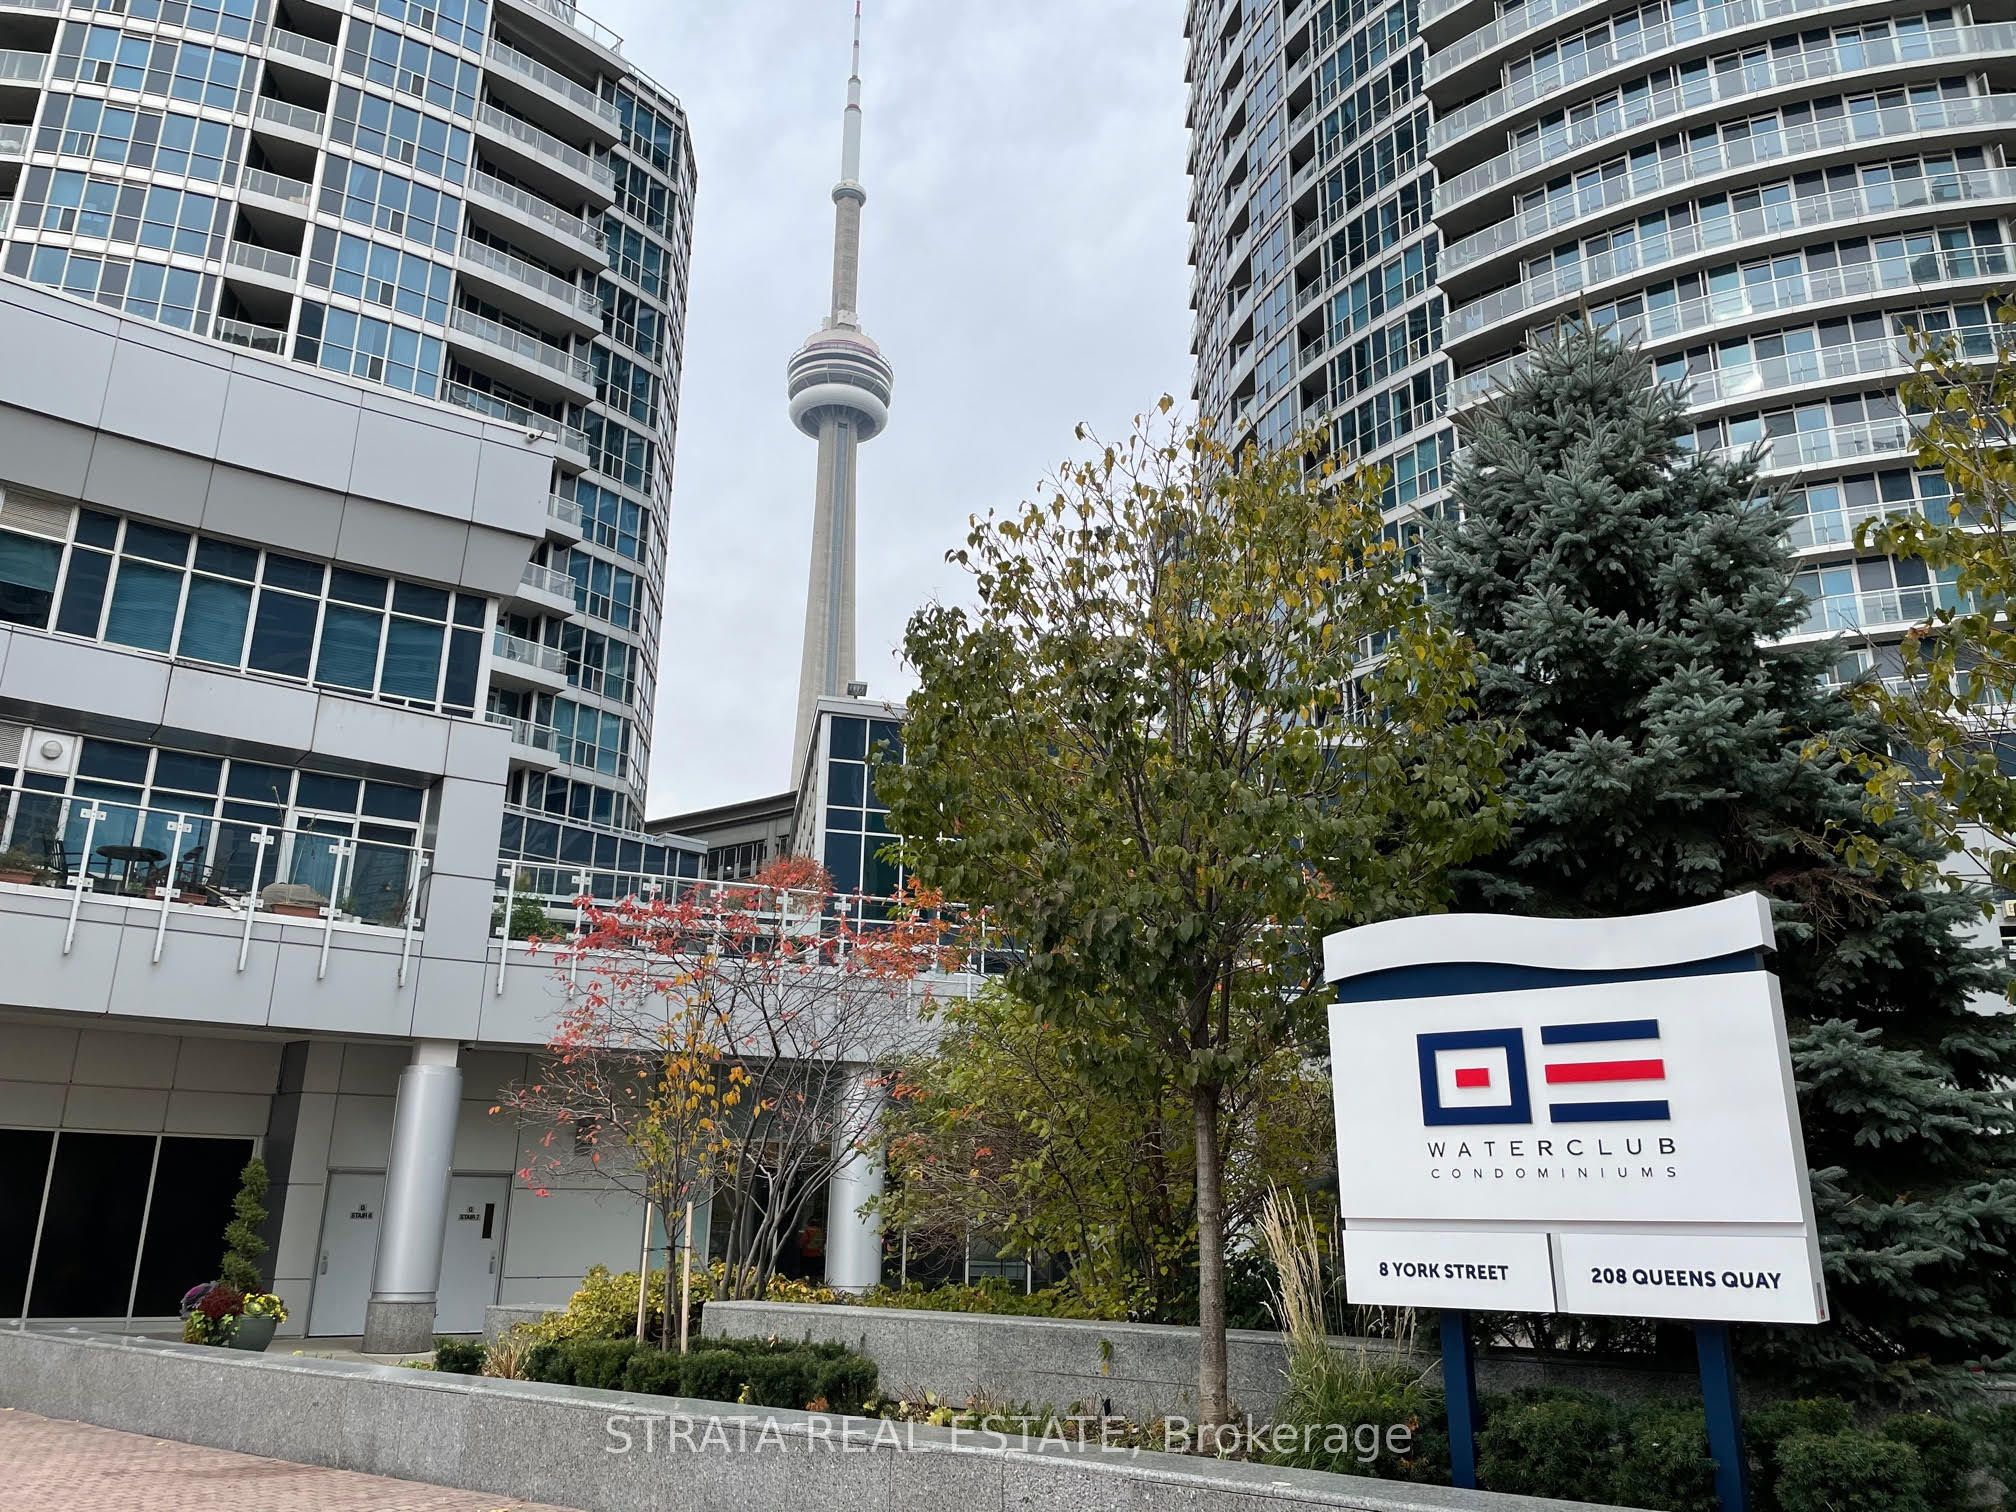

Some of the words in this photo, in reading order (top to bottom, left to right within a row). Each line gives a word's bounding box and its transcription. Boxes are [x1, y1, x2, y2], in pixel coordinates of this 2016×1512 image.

[1427, 1137, 1677, 1158] WATERCLUB
[1430, 1166, 1677, 1179] CONDOMINIUMS
[1379, 1261, 1389, 1277] 8
[1392, 1262, 1441, 1279] YORK
[1444, 1263, 1509, 1281] STREET
[1591, 1267, 1628, 1285] 208
[1632, 1268, 1717, 1288] QUEENS
[1721, 1271, 1781, 1290] QUAY
